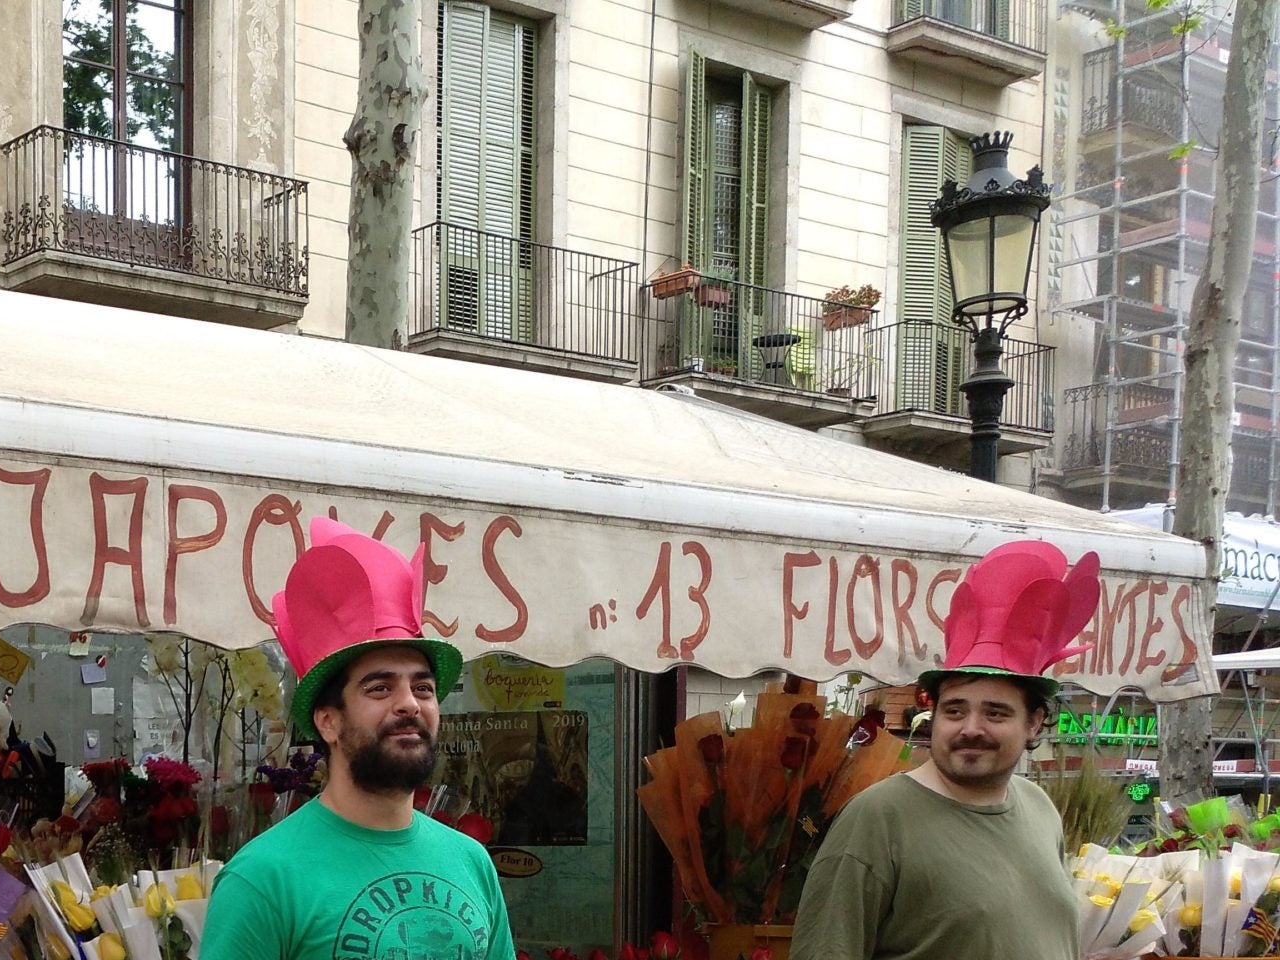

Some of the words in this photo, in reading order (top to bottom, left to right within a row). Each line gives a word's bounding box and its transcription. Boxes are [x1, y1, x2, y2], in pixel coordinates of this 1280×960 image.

[635, 540, 713, 661] 13
[440, 720, 482, 732] mana
[486, 717, 528, 732] Santa
[552, 714, 585, 728] 2019
[436, 738, 481, 754] rcelona
[500, 854, 521, 865] Flor
[523, 857, 534, 866] 10
